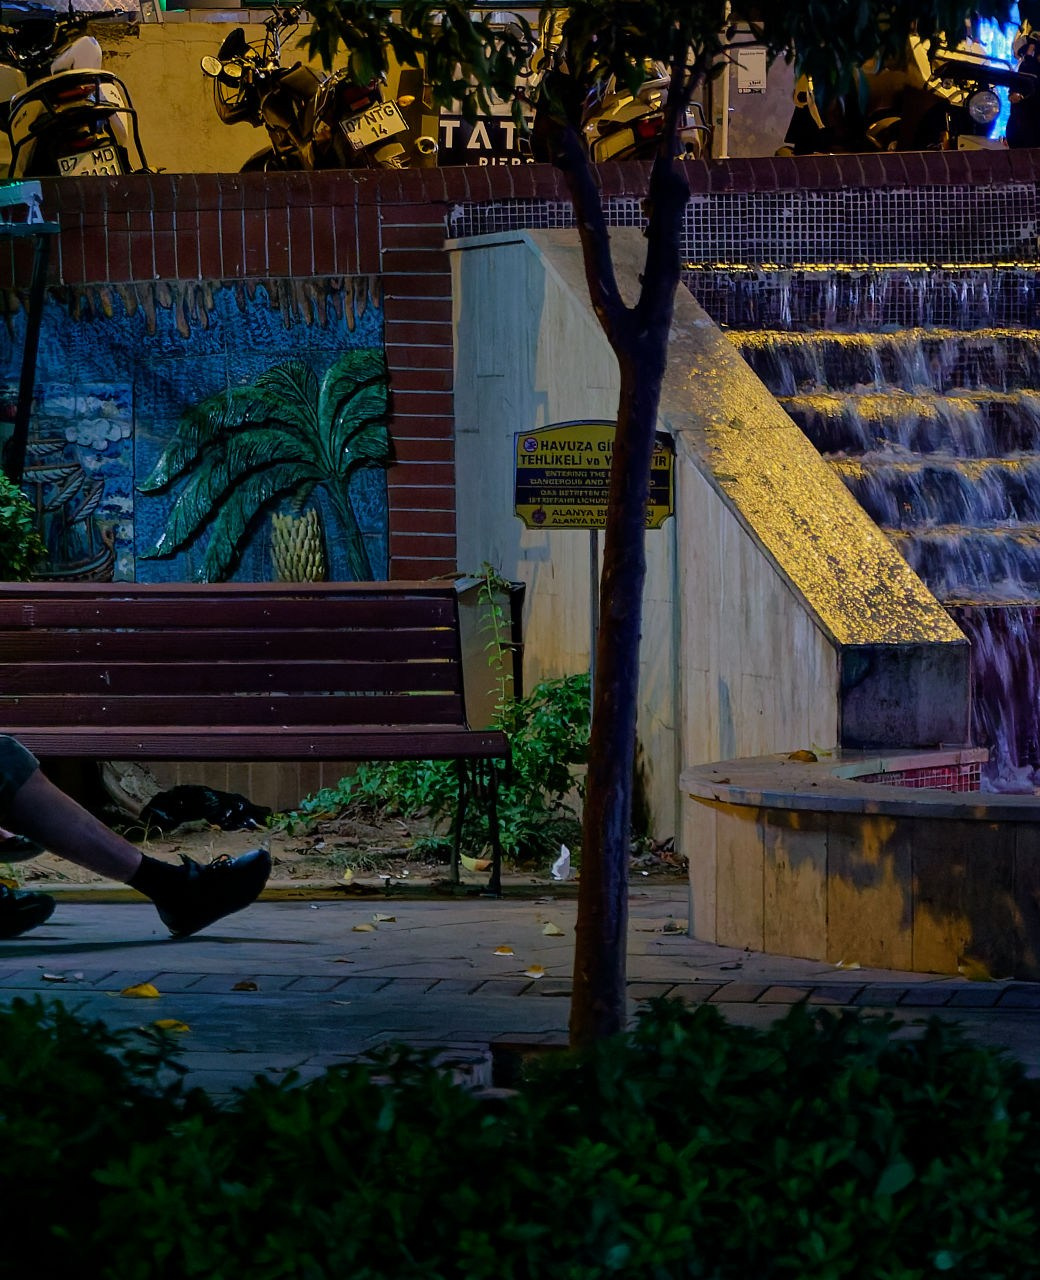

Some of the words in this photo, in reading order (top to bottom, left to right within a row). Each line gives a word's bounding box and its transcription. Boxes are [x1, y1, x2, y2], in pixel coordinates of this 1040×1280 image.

[364, 105, 395, 125] NTG
[371, 124, 388, 138] 14
[60, 156, 78, 172] 07
[541, 440, 593, 452] HAVUZA
[520, 452, 582, 466] TEHLİKELİ
[552, 509, 594, 517] ALANYA
